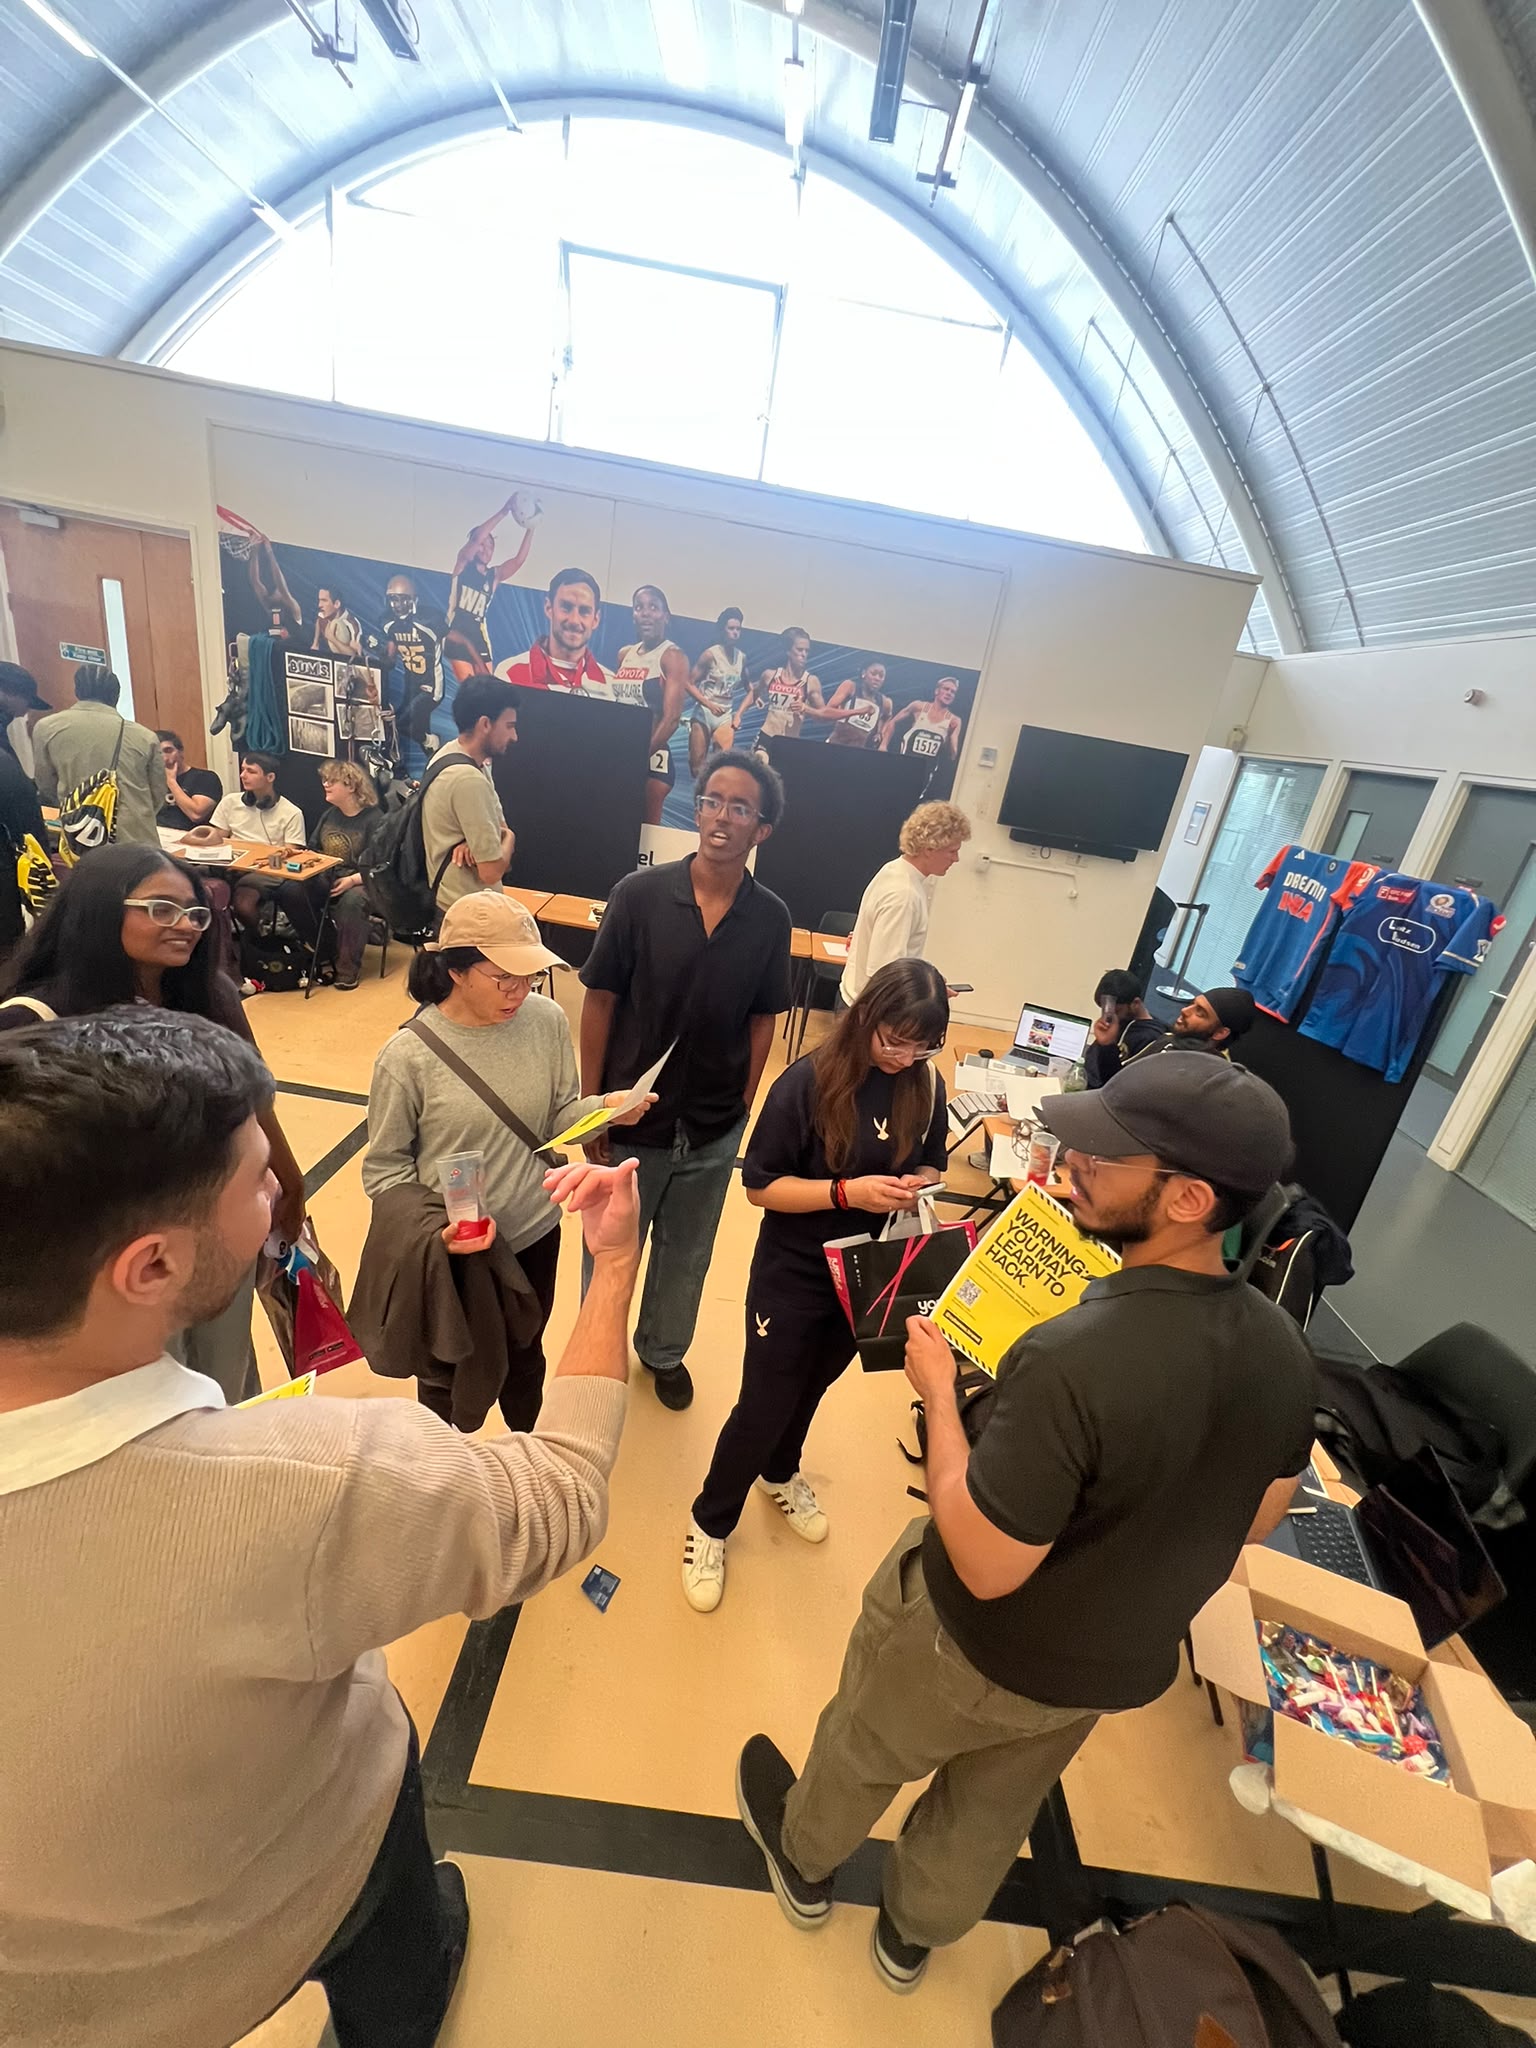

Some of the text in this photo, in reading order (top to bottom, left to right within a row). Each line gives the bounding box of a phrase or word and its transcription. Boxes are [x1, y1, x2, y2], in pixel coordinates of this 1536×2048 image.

[656, 753, 664, 769] 2
[915, 739, 938, 755] 1512
[985, 1244, 1029, 1289] HACK.
[994, 1232, 1045, 1280] LEARN
[1042, 1273, 1065, 1297] TO
[1006, 1220, 1039, 1252] YOU
[1034, 1250, 1071, 1279] MAY
[1014, 1208, 1089, 1280] WARNING:
[917, 1299, 939, 1315] yo
